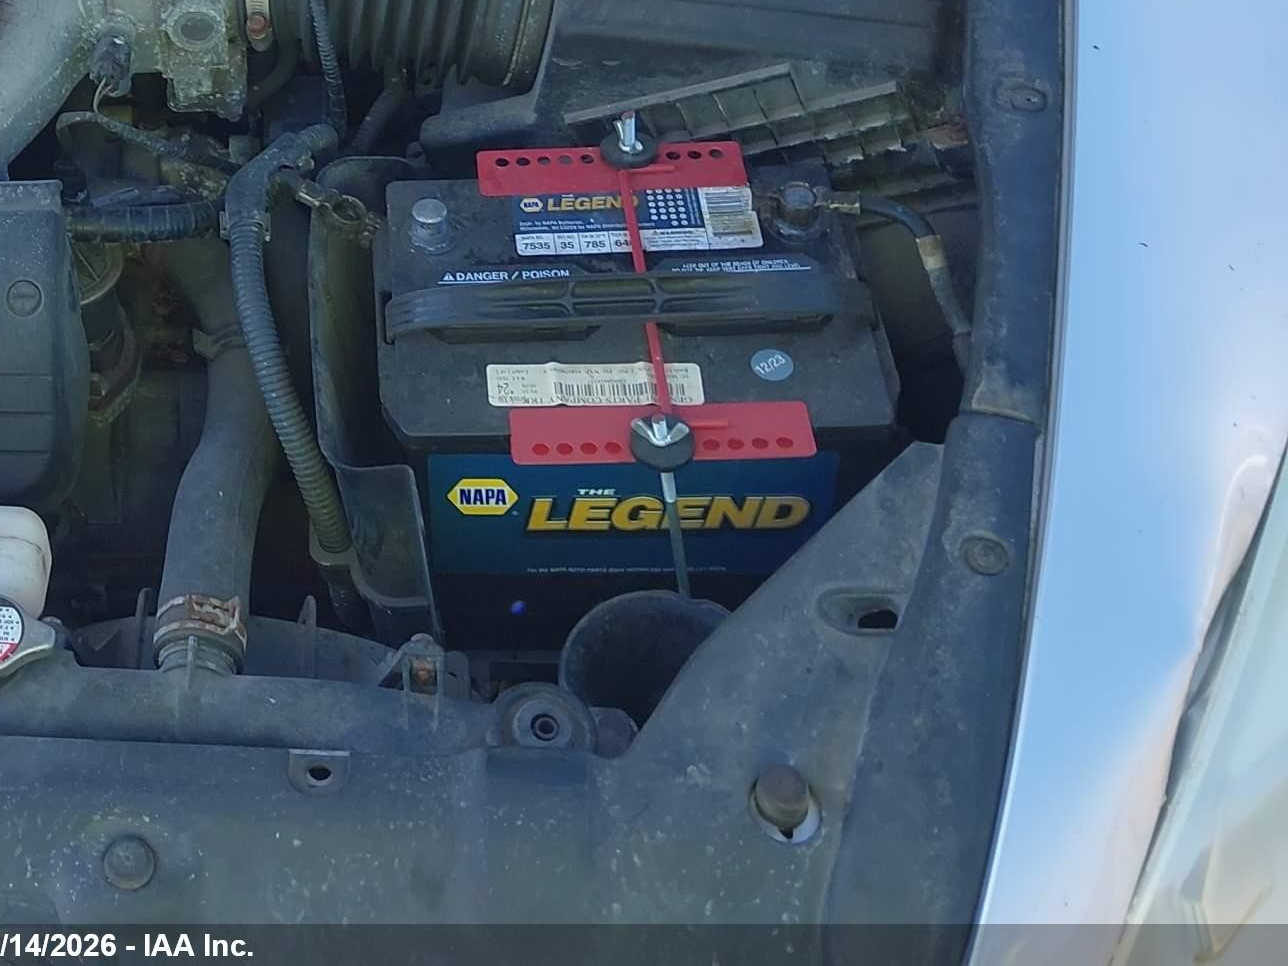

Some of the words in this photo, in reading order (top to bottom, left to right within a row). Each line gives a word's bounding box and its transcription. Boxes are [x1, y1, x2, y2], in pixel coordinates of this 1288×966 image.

[547, 195, 639, 211] LEGEN
[522, 241, 551, 251] 7535
[560, 241, 575, 250] 35
[585, 240, 606, 249] 785
[615, 239, 632, 248] 64
[456, 272, 509, 281] DANGER
[521, 269, 571, 279] POISON
[755, 354, 786, 375] 12/23
[459, 488, 508, 506] NAPA
[526, 495, 812, 531] LEGEND
